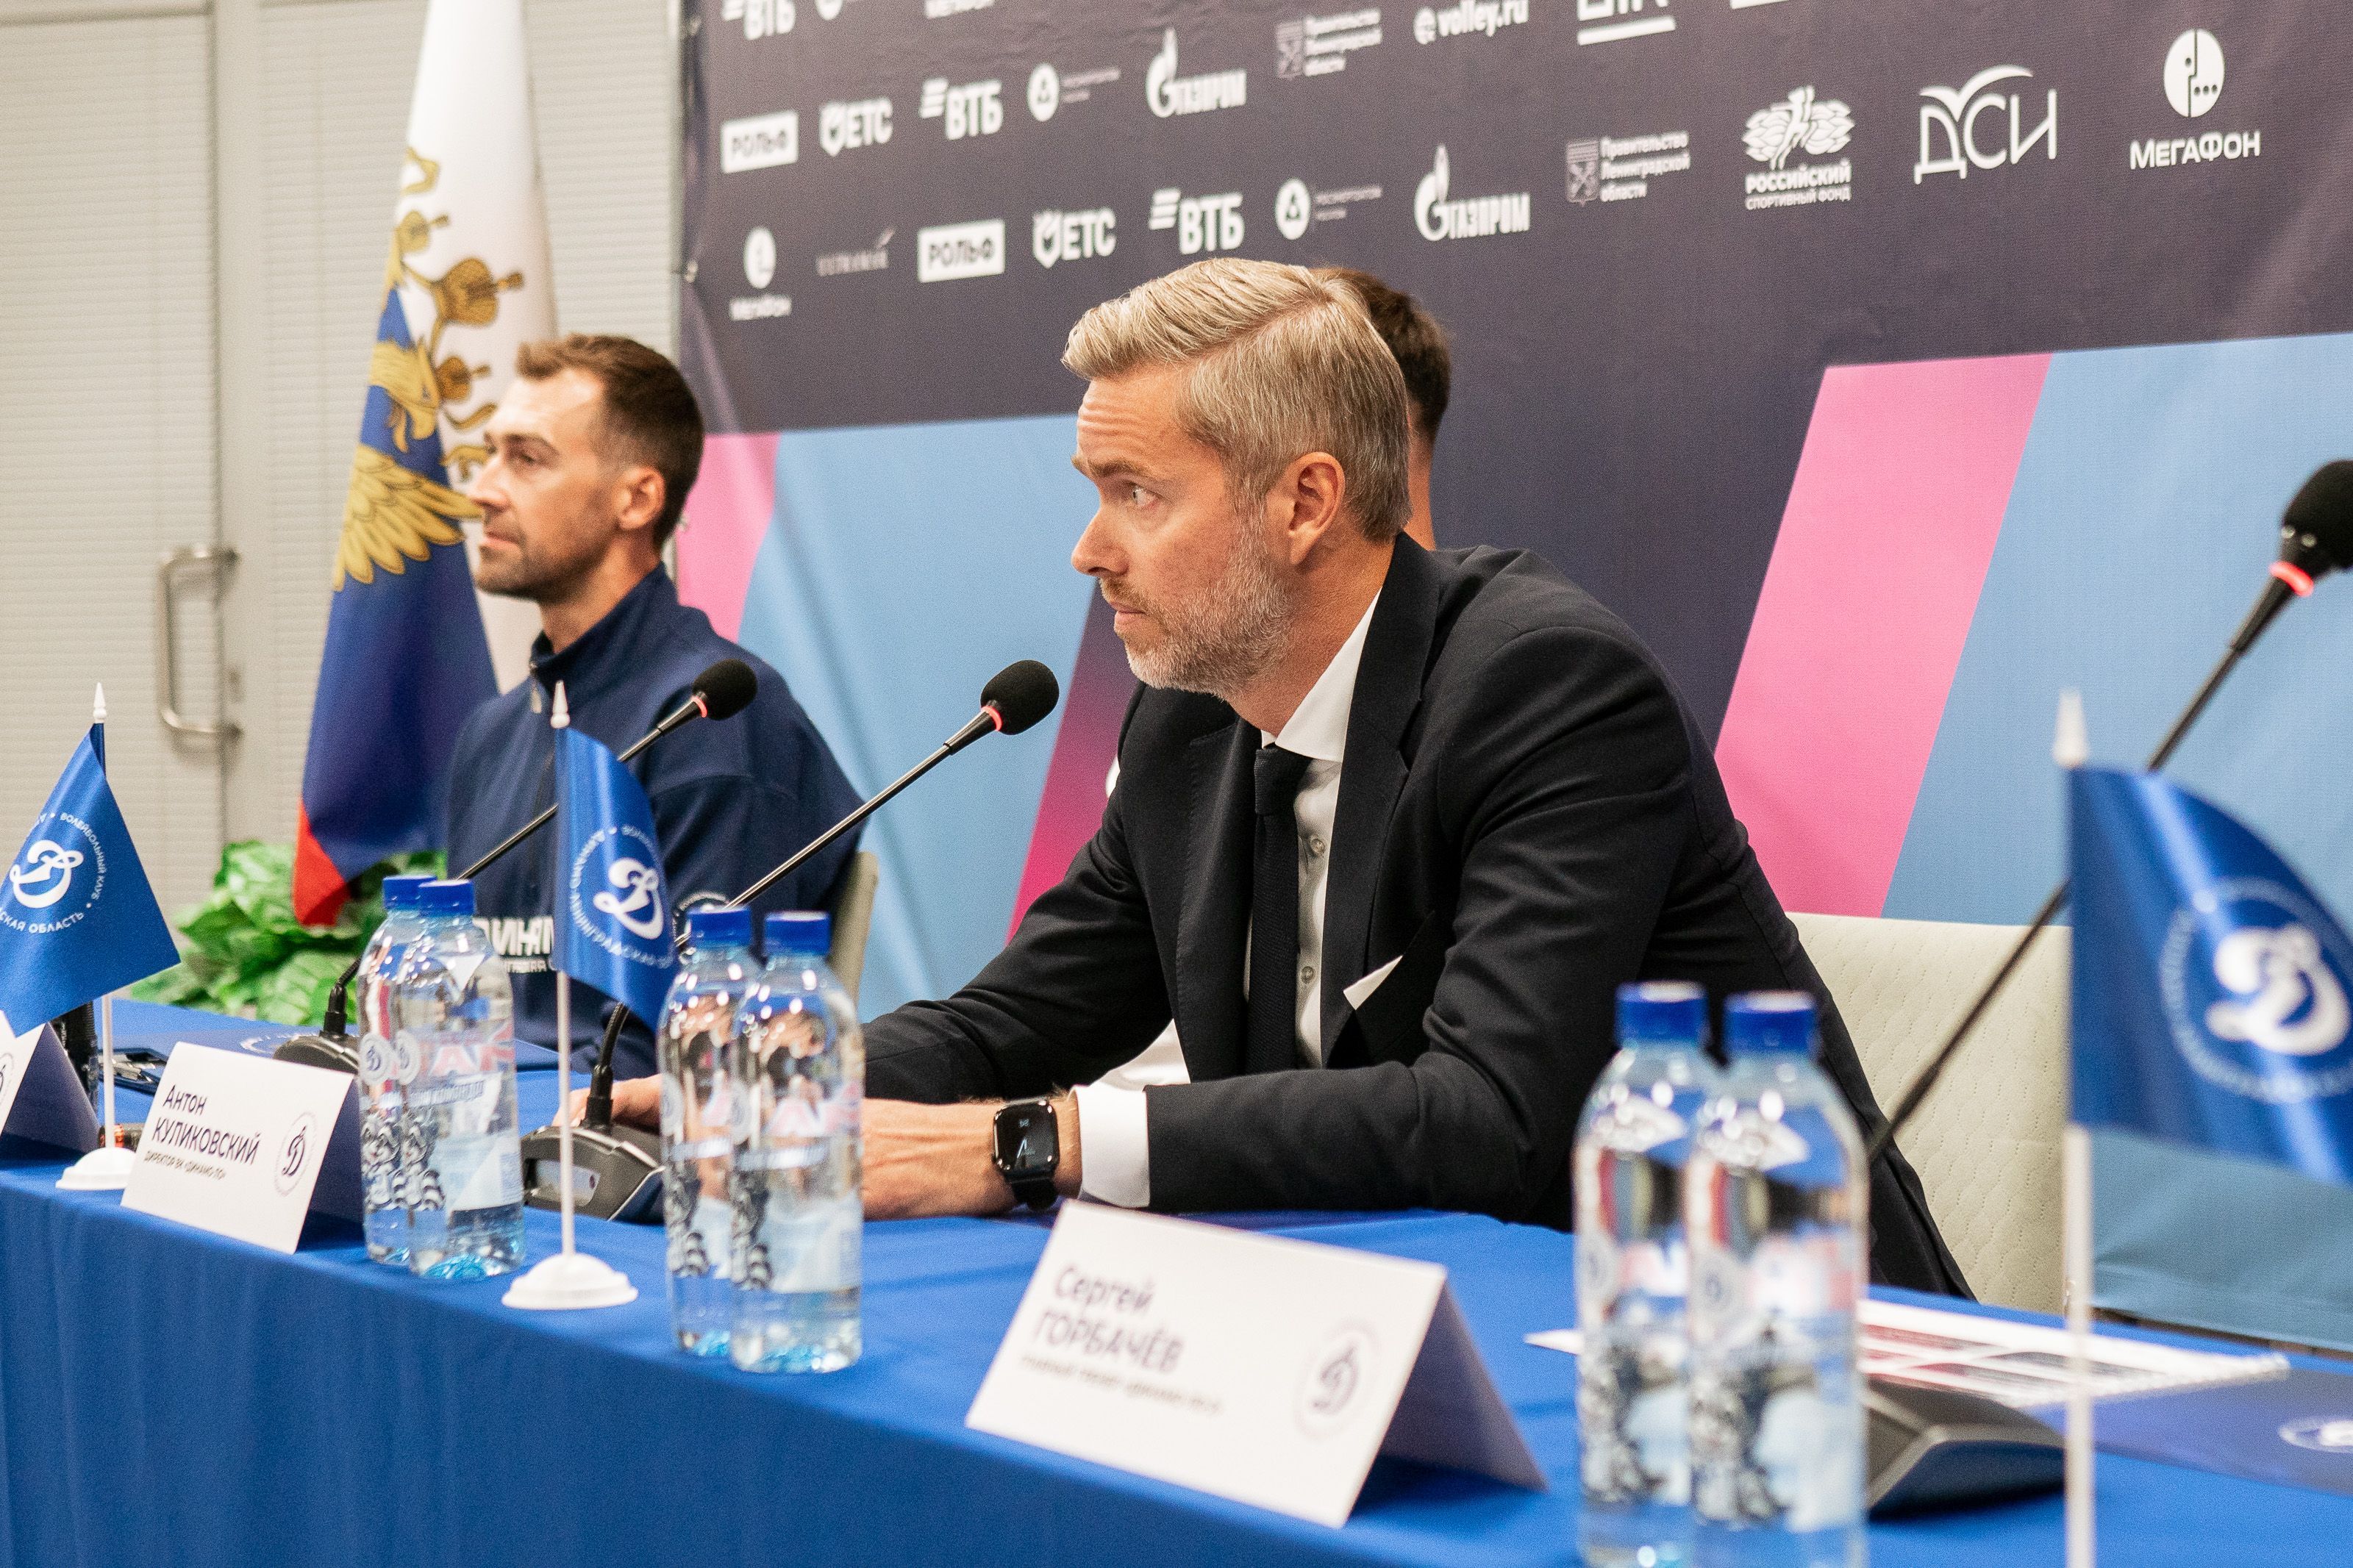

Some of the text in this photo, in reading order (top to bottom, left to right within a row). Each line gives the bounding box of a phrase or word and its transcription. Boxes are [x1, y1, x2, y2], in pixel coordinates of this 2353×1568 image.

[946, 79, 1003, 140] ВТБ
[1600, 131, 1689, 159] Правительство
[1914, 87, 2057, 185] ДСИ
[1600, 151, 1690, 180] Ленинградской
[1746, 159, 1852, 194] РОССИЙСКИЙ
[1599, 182, 1647, 202] области
[1746, 186, 1852, 210] СПОРТИВНЫЙ ФОНД
[1178, 193, 1246, 255] ВТБ
[928, 237, 995, 271] РОЛЬФ
[60, 812, 107, 873] ВОЛЕЙБОЛЬНЫЙ
[28, 912, 85, 934] ОБЛАСТЬ
[151, 1116, 262, 1165] КУЛИКОВСКИЙ
[1054, 1264, 1154, 1314] Сергей
[1032, 1309, 1185, 1373] ГОРБАЧЁВ
